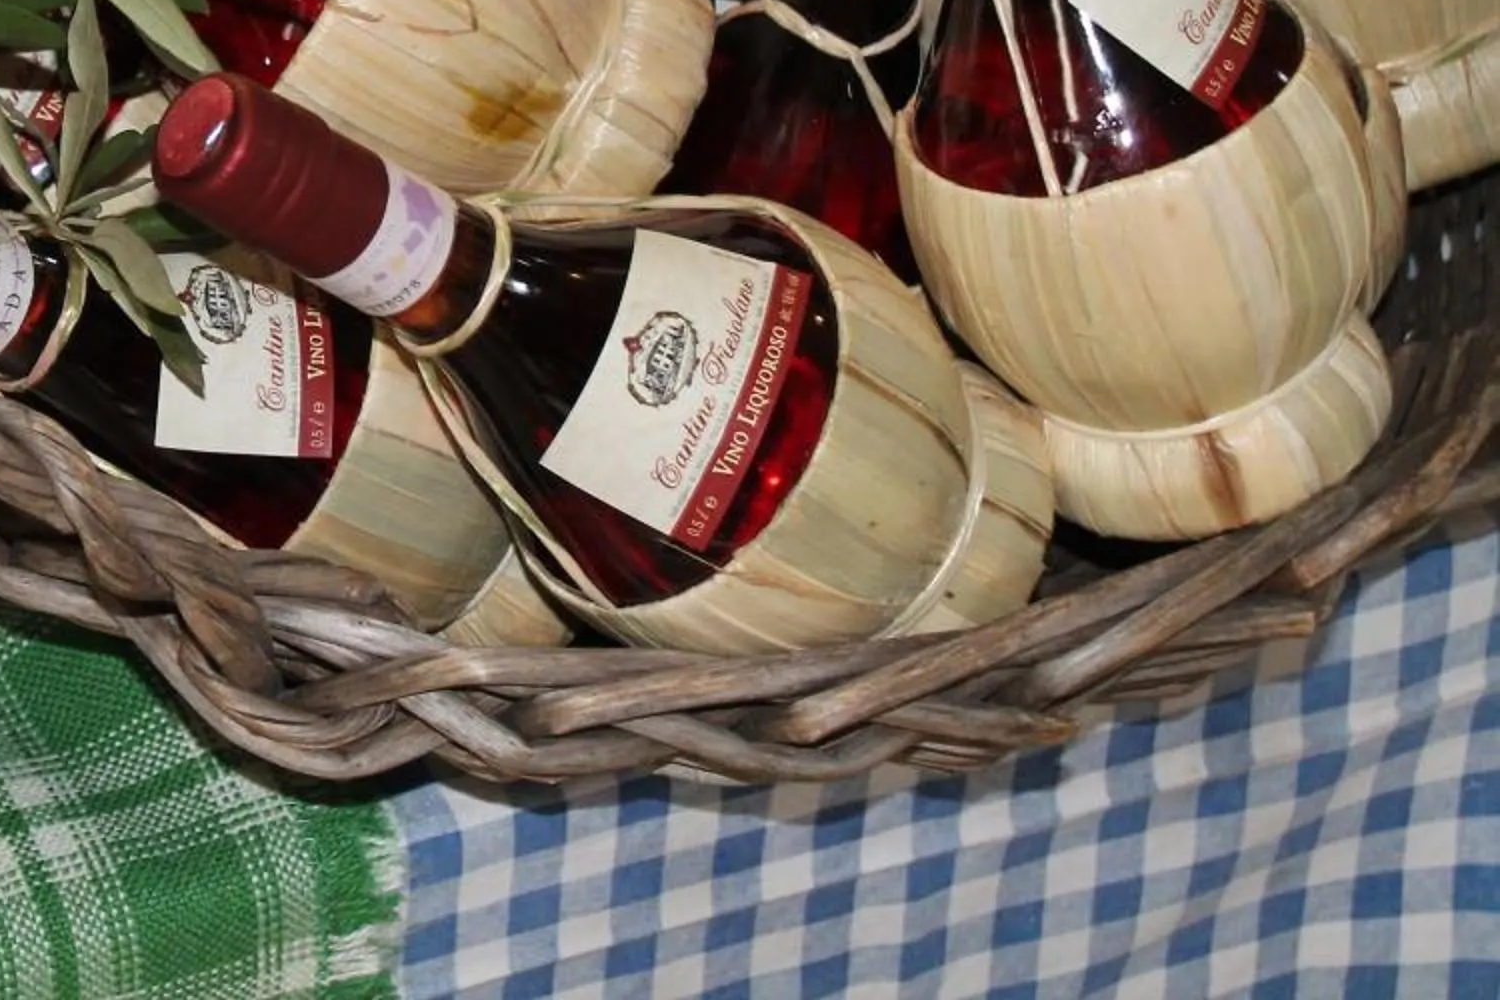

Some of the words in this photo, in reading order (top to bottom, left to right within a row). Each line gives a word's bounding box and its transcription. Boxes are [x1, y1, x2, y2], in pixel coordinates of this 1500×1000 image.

[35, 90, 64, 123] VIN
[256, 313, 285, 412] Cantine
[307, 334, 327, 380] VINO
[650, 393, 718, 489] Cantine
[701, 277, 754, 386] Fiesolane
[711, 431, 749, 476] VINO
[737, 325, 788, 427] LIQUOROSO
